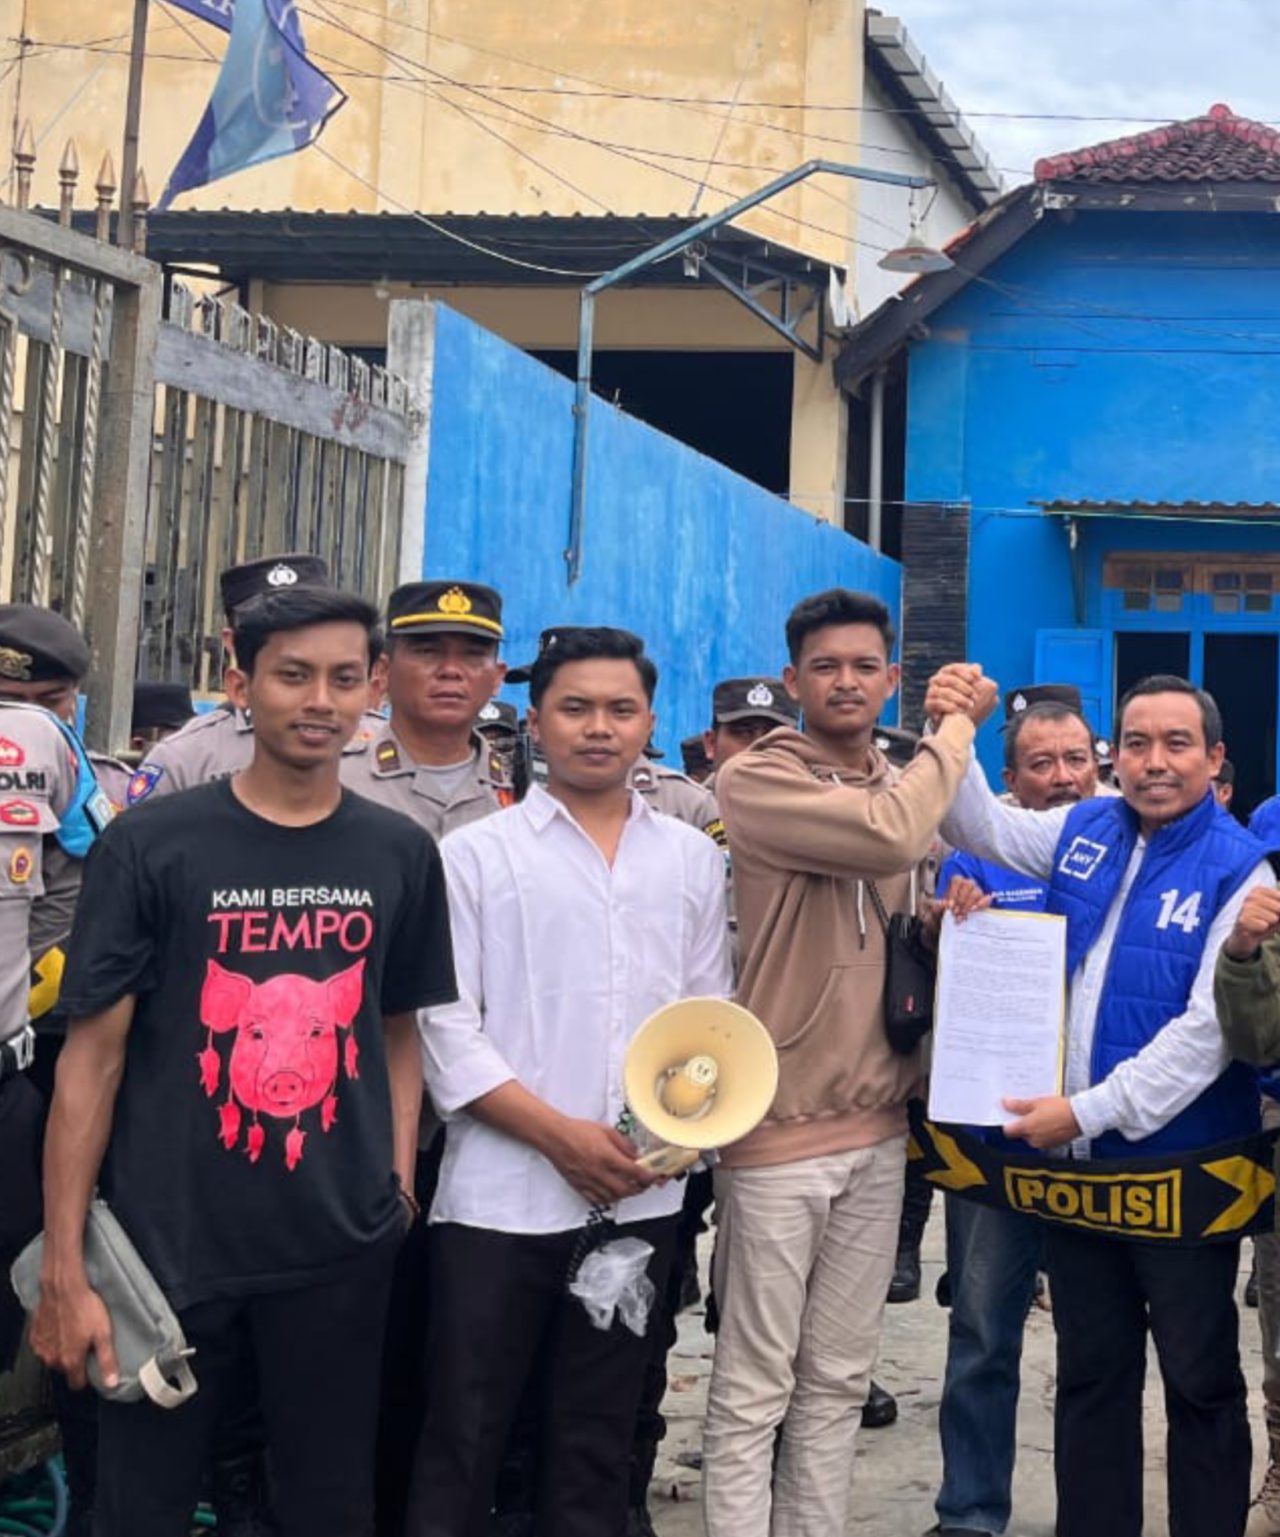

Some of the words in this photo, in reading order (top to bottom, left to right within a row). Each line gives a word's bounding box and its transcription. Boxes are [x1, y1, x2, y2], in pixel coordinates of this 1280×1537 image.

[213, 888, 266, 908] KAMI
[272, 887, 373, 907] BERSAMA
[1155, 888, 1203, 933] 14
[207, 909, 374, 953] TEMPO
[1017, 1178, 1169, 1229] POLISI
